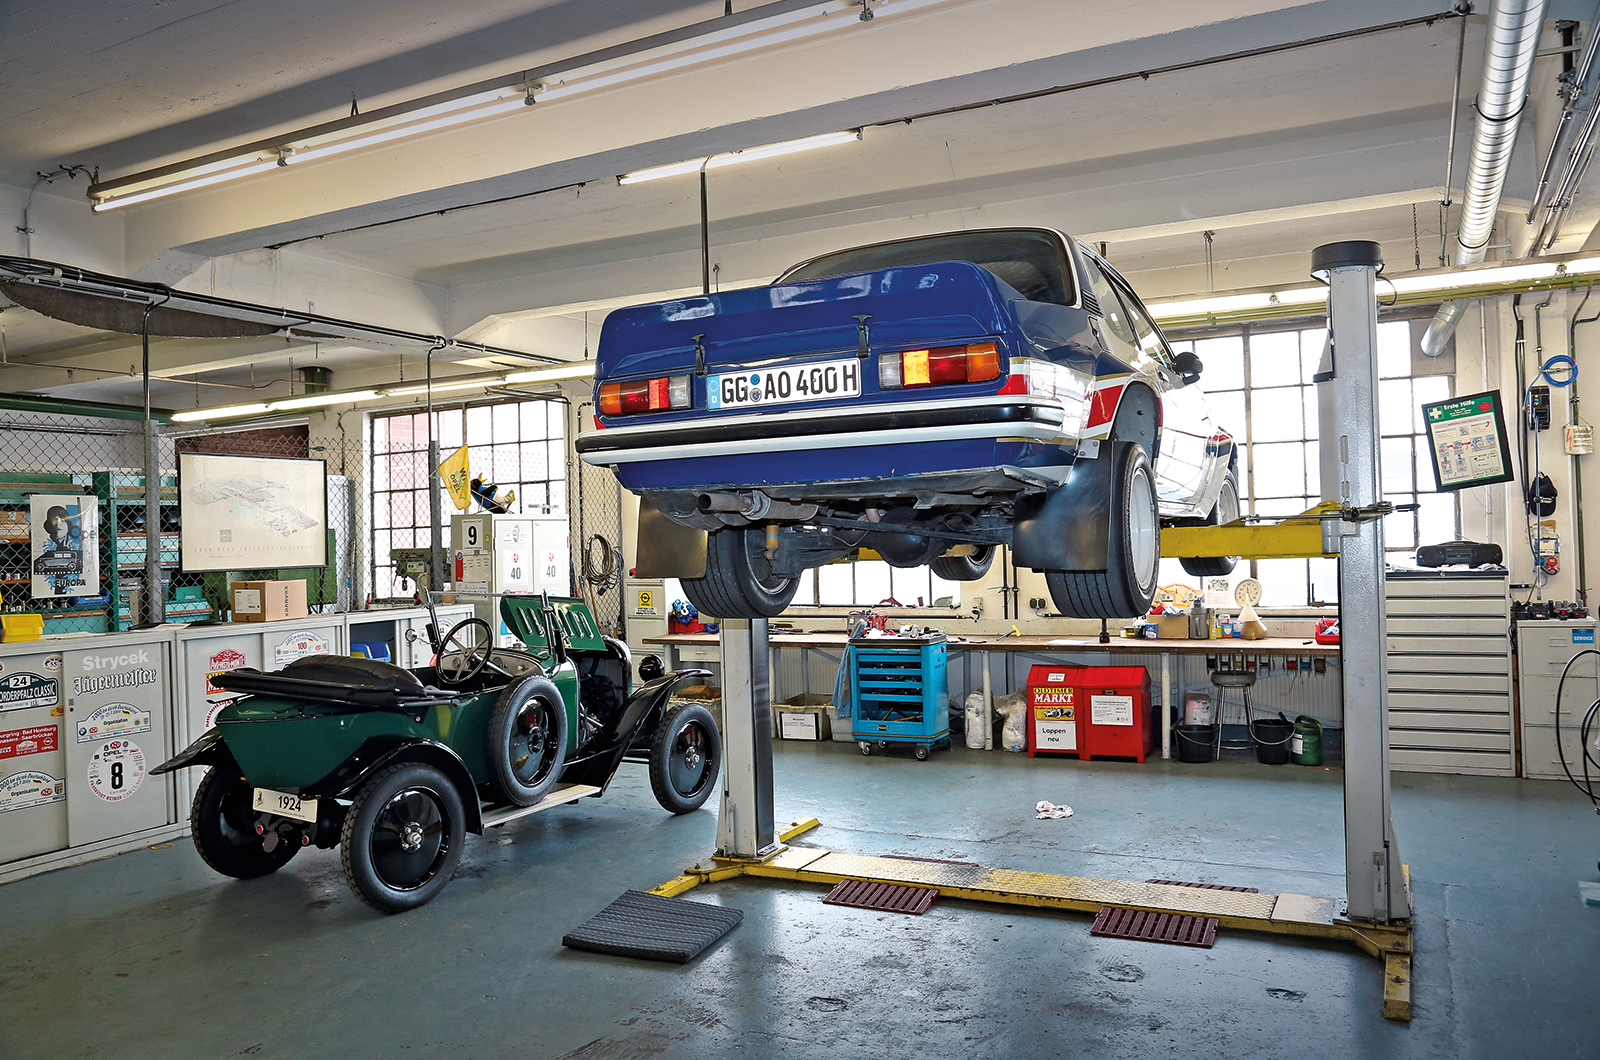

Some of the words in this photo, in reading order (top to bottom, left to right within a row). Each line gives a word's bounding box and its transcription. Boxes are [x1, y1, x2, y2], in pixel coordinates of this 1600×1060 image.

[722, 377, 748, 403] GG
[765, 371, 791, 399] AO
[796, 367, 838, 395] 400
[843, 364, 857, 392] H
[450, 474, 460, 493] OPEL
[468, 526, 477, 545] 9
[511, 567, 521, 579] 40
[546, 565, 556, 577] 40
[56, 579, 86, 587] EUROPA
[297, 642, 307, 650] 100
[82, 650, 149, 671] Strycek
[13, 677, 27, 686] 24
[34, 683, 55, 697] CLASSIC
[1034, 693, 1074, 702] MARKT
[103, 718, 128, 726] Organisation
[111, 762, 123, 789] 8
[11, 788, 39, 797] Organisation
[279, 795, 301, 812] 1924
